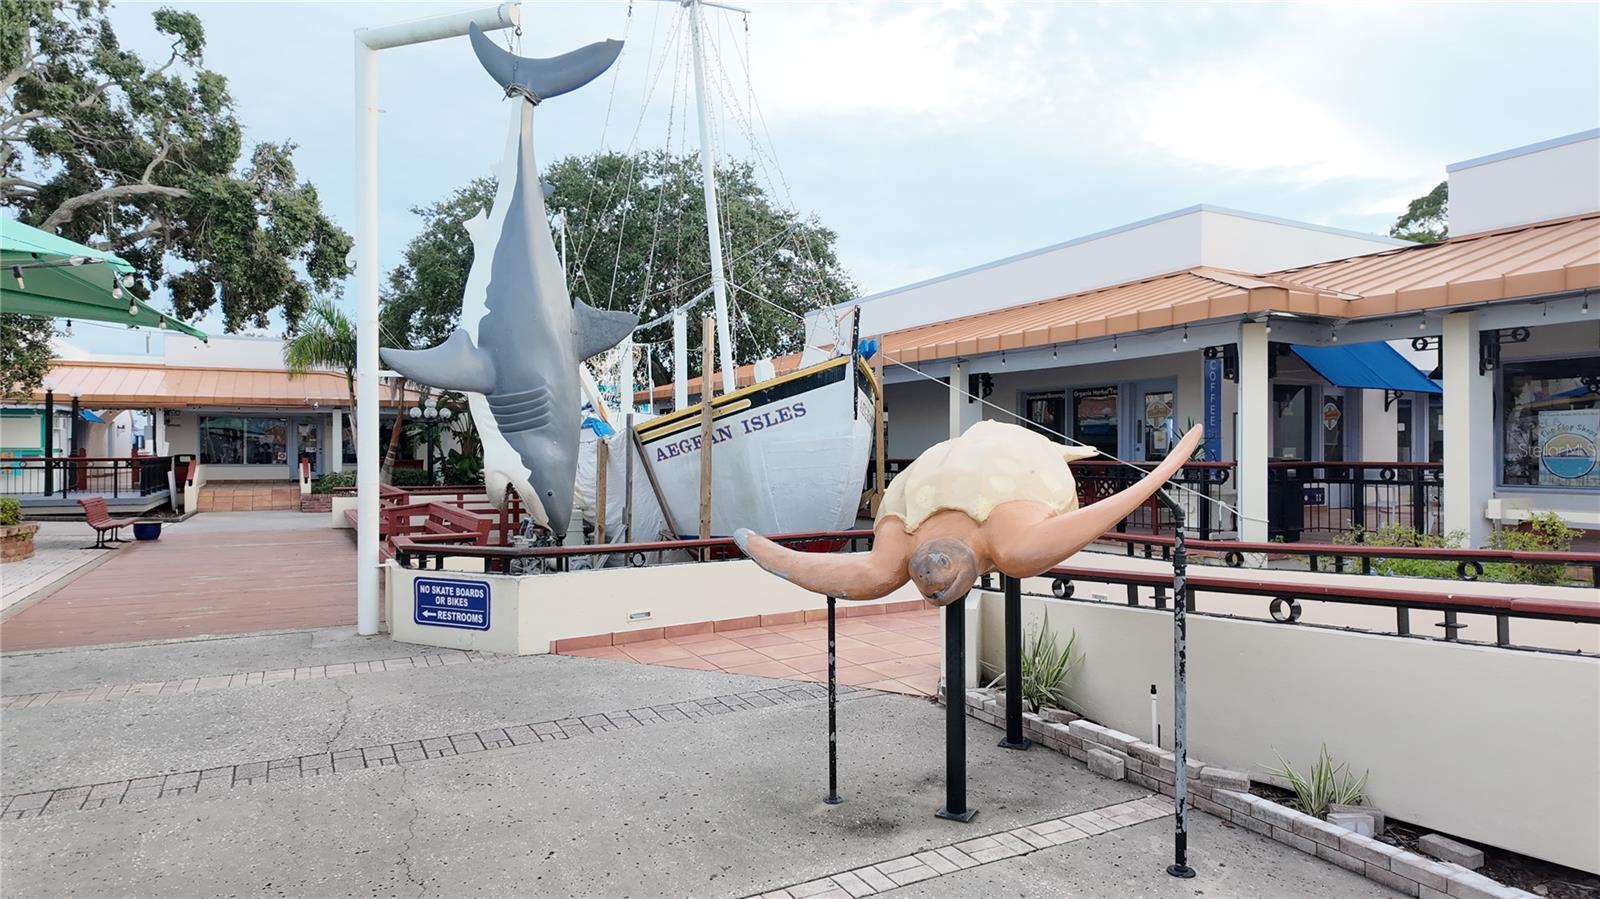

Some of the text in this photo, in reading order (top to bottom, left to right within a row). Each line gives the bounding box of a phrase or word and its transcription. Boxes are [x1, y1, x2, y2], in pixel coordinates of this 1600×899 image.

[1209, 360, 1217, 427] COFFEE
[657, 402, 807, 462] AEGEAN ISLES
[1557, 423, 1574, 431] Flop
[420, 585, 484, 598] NO SKATE BOARDS
[435, 596, 469, 607] OR BIKES
[437, 610, 483, 623] RESTROOMS
